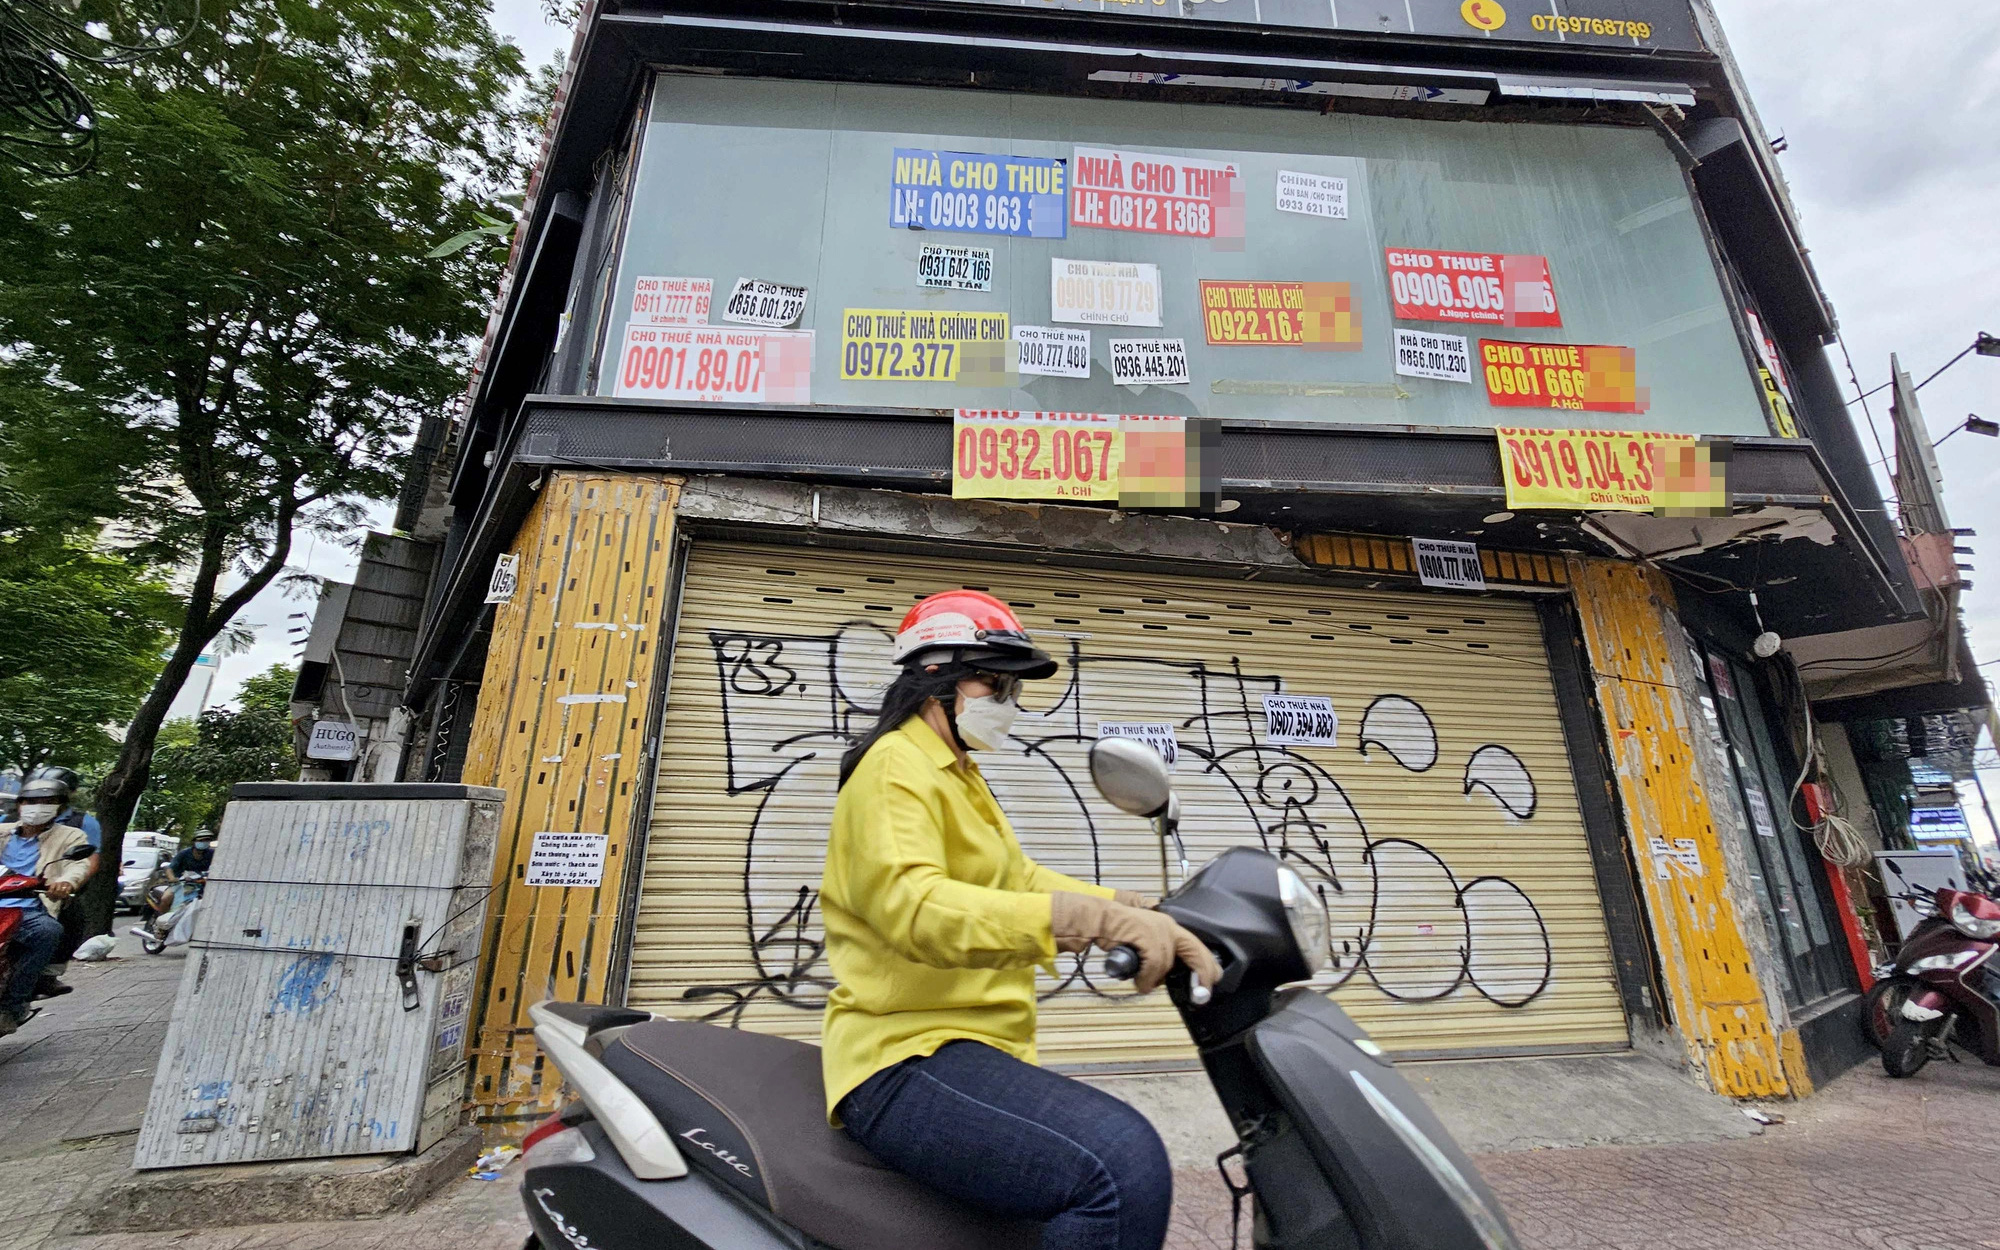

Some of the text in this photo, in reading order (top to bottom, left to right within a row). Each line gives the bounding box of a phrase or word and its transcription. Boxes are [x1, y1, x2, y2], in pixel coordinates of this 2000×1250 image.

[1531, 14, 1651, 39] 0769768789
[895, 152, 1064, 195] NHÀ CHO THUÊ
[1077, 153, 1125, 189] NHÀ
[1131, 162, 1176, 194] CHO
[894, 189, 923, 224] LH:
[930, 191, 979, 228] 0903
[985, 194, 1021, 231] 963
[1074, 191, 1103, 224] LH:
[1109, 194, 1158, 230] 0812
[1163, 200, 1211, 235] 1368
[1279, 199, 1345, 216] 0933 621 124
[923, 246, 942, 255] CHO
[945, 248, 969, 257] THUÊ
[1388, 252, 1434, 268] CHO
[1438, 254, 1495, 273] THUÊ
[919, 255, 991, 282] 0931 642 166
[1067, 263, 1088, 276] CHO
[637, 279, 711, 292] CHO THUÊ NHÀ
[757, 283, 777, 296] CHO
[925, 278, 952, 287] ANH
[634, 293, 710, 314] 0911 7777 69
[1056, 276, 1095, 309] 0909
[1098, 279, 1115, 311] 19
[1135, 281, 1154, 313] 29
[1205, 287, 1228, 308] CHO
[1229, 283, 1257, 309] THUÊ
[1258, 284, 1282, 309] NHÀ
[847, 311, 1005, 340] CHO THUÊ NHÀ CHÍNH CHỦ
[1080, 312, 1129, 323] CHÍNH CHỦ
[631, 330, 656, 342] CHO
[661, 330, 691, 344] THUÊ
[696, 331, 722, 345] NHÀ
[1020, 330, 1086, 342] CHO THUÊ NHÀ
[1113, 341, 1183, 353] CHO THUÊ NHÀ
[1400, 334, 1463, 353] NHÀ CHO THUÊ
[845, 341, 955, 378] 0972.377
[1114, 355, 1187, 378] 0936.445.201
[1400, 349, 1467, 373] 0856.001.230
[1484, 345, 1582, 367] CHO THUÊ
[1486, 365, 1541, 396] 0901
[958, 427, 1112, 482] 0932.067
[1419, 543, 1474, 555] CHO THUÊ NHÀ
[1420, 554, 1481, 582] 0908.777.488
[1268, 700, 1328, 711] CHO THUÊ NHÀ
[1103, 726, 1120, 735] CHO
[1123, 725, 1144, 735] THUÊ
[1271, 710, 1333, 738] 0907.594.883
[315, 729, 355, 742] HUGO
[680, 1128, 752, 1178] Latte
